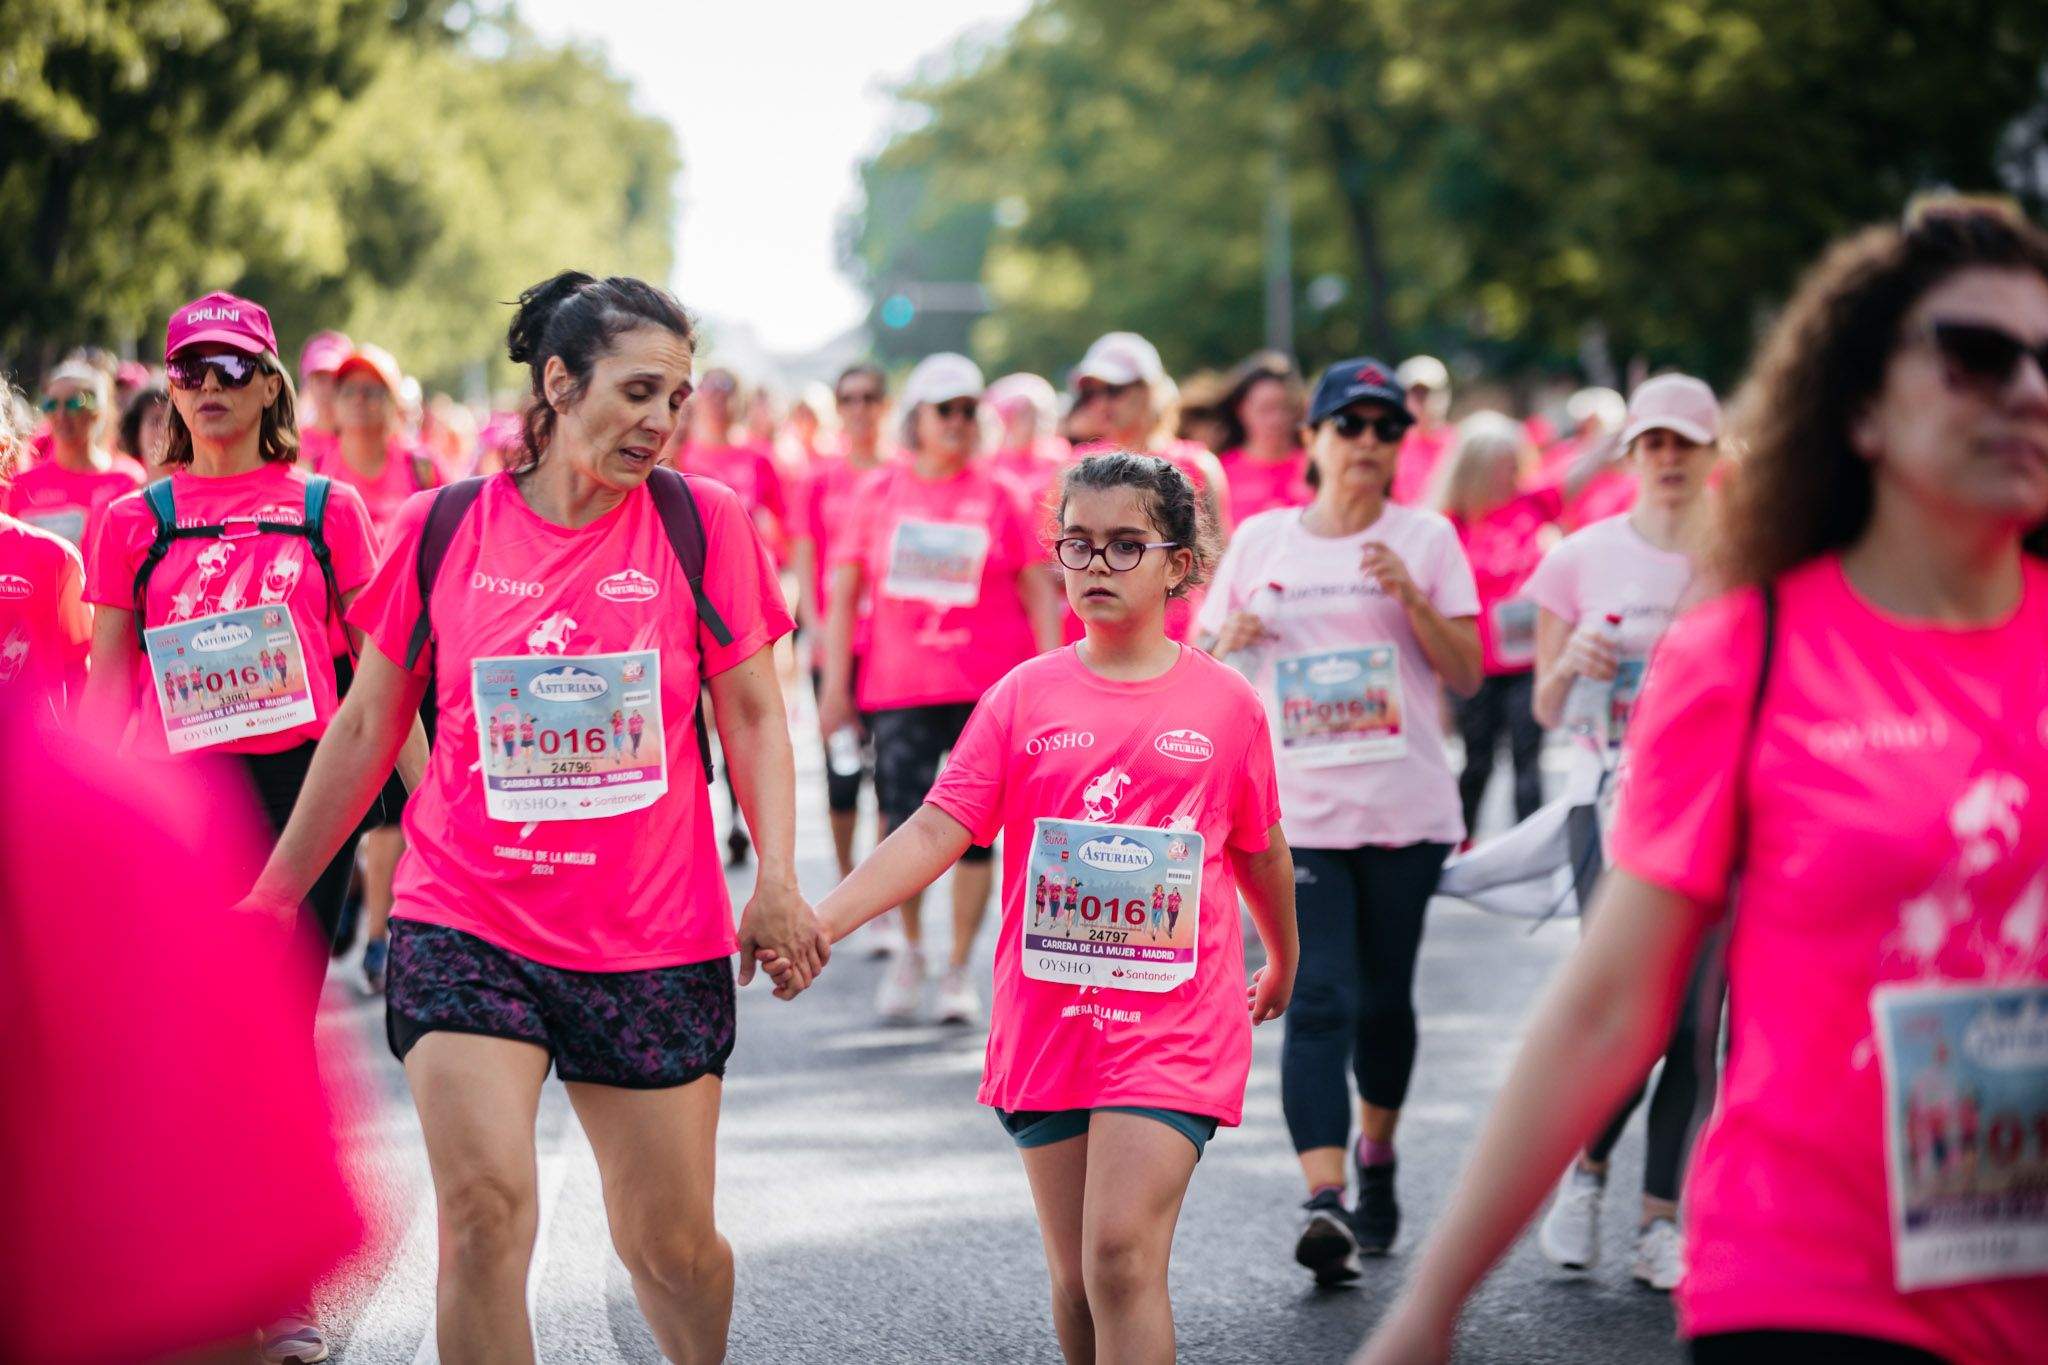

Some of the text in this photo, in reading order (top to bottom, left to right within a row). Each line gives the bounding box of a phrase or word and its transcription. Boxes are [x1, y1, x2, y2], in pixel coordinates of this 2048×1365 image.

[187, 307, 240, 325] DRUNI
[470, 572, 545, 599] OYSHO
[603, 582, 656, 595] ASTURIANA
[196, 632, 250, 650] ASTURIANA
[206, 666, 260, 692] 016
[535, 680, 604, 694] ASTURIANA
[538, 728, 607, 755] 016
[1025, 731, 1096, 756] OYSHO
[551, 761, 593, 774] 24796
[501, 770, 644, 789] CARRERA DE LA MUJER MADRID
[501, 796, 559, 811] OYSHO
[594, 791, 647, 807] Santander
[1044, 836, 1069, 846] SUMA
[493, 845, 597, 866] CARRERA DE LA MUJER
[1083, 846, 1150, 865] ASTURIANA
[1080, 895, 1146, 926] 016
[1088, 929, 1129, 943] 24797
[1041, 938, 1175, 960] CARRERA DE LA MUJER MADRID
[1039, 957, 1092, 975] OYSHO
[1125, 968, 1177, 982] Santander
[1101, 1006, 1112, 1020] LA
[1112, 1009, 1142, 1024] MUJER
